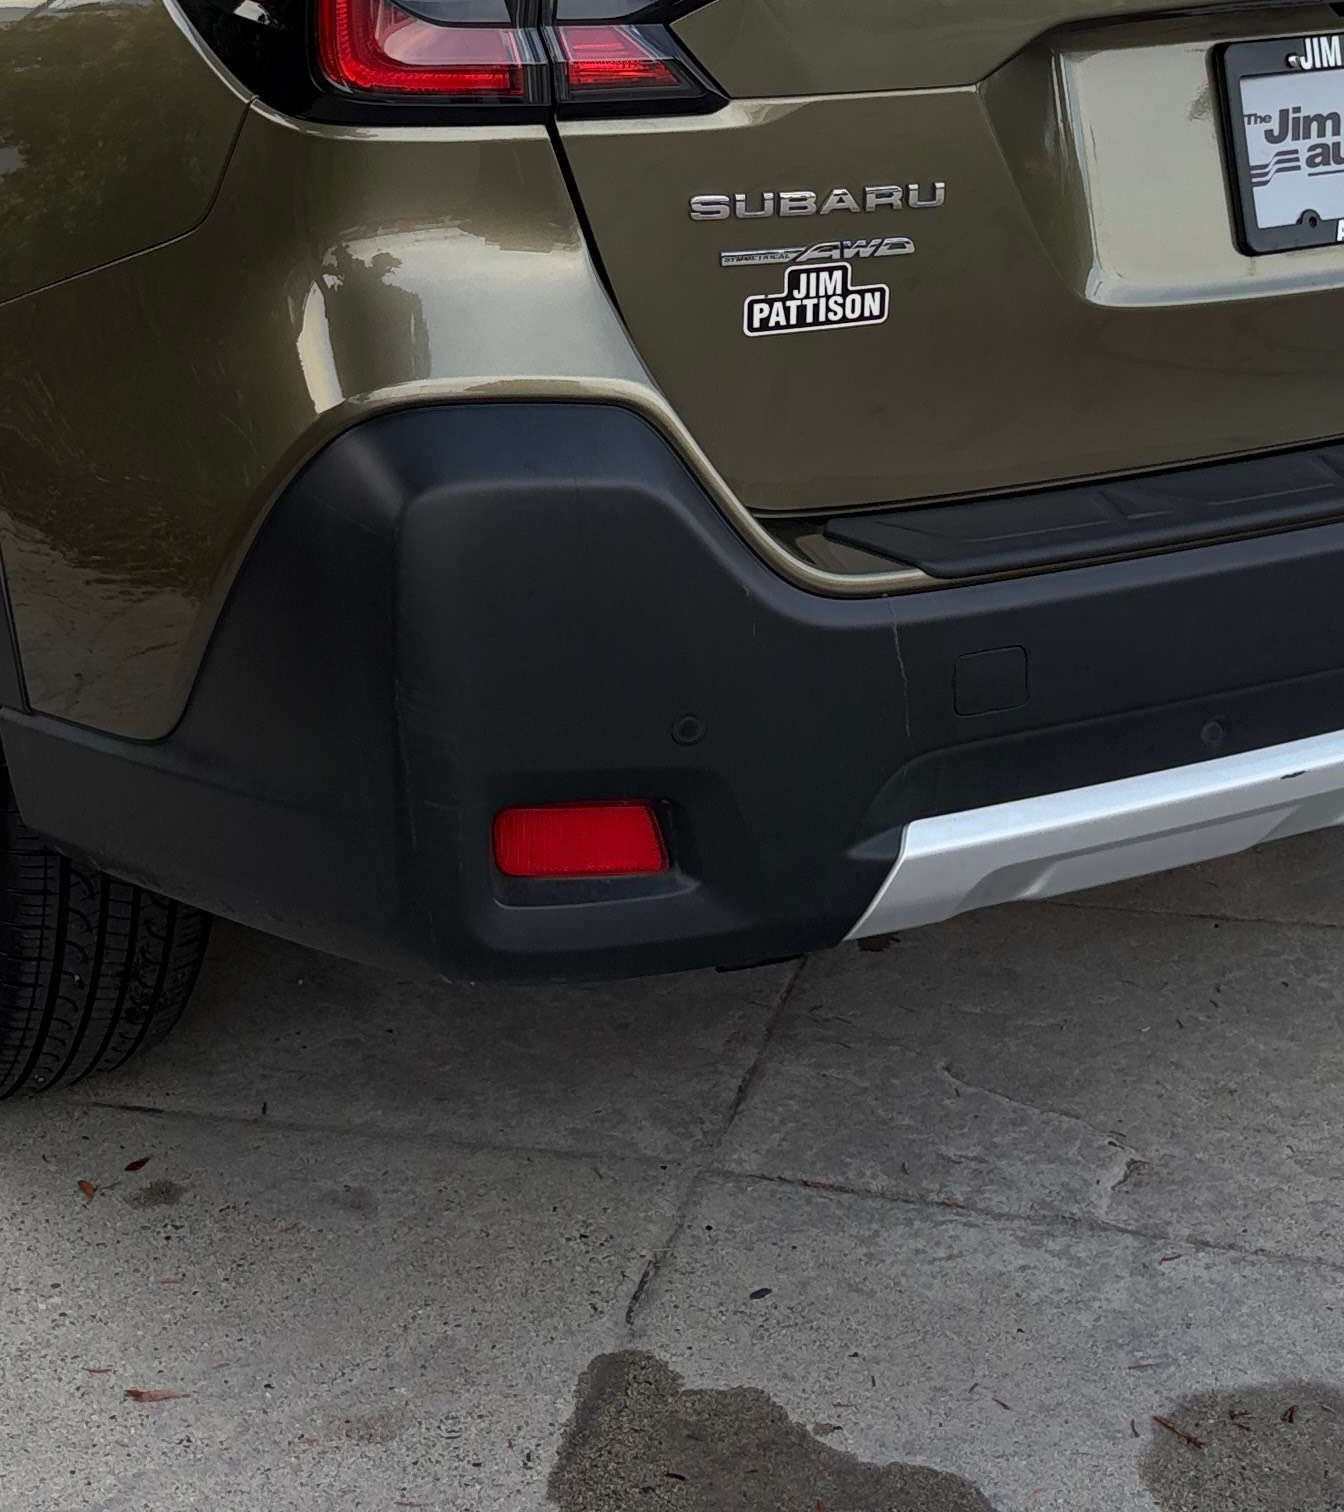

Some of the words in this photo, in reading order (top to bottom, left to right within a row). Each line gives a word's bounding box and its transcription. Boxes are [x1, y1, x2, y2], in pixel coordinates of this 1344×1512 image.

[1299, 37, 1343, 69] JIM
[1244, 113, 1273, 126] The
[1264, 106, 1341, 144] Jim
[689, 182, 945, 220] SUBARU
[795, 238, 916, 262] AWD
[793, 270, 843, 299] JIM
[753, 292, 881, 328] PATTISON
